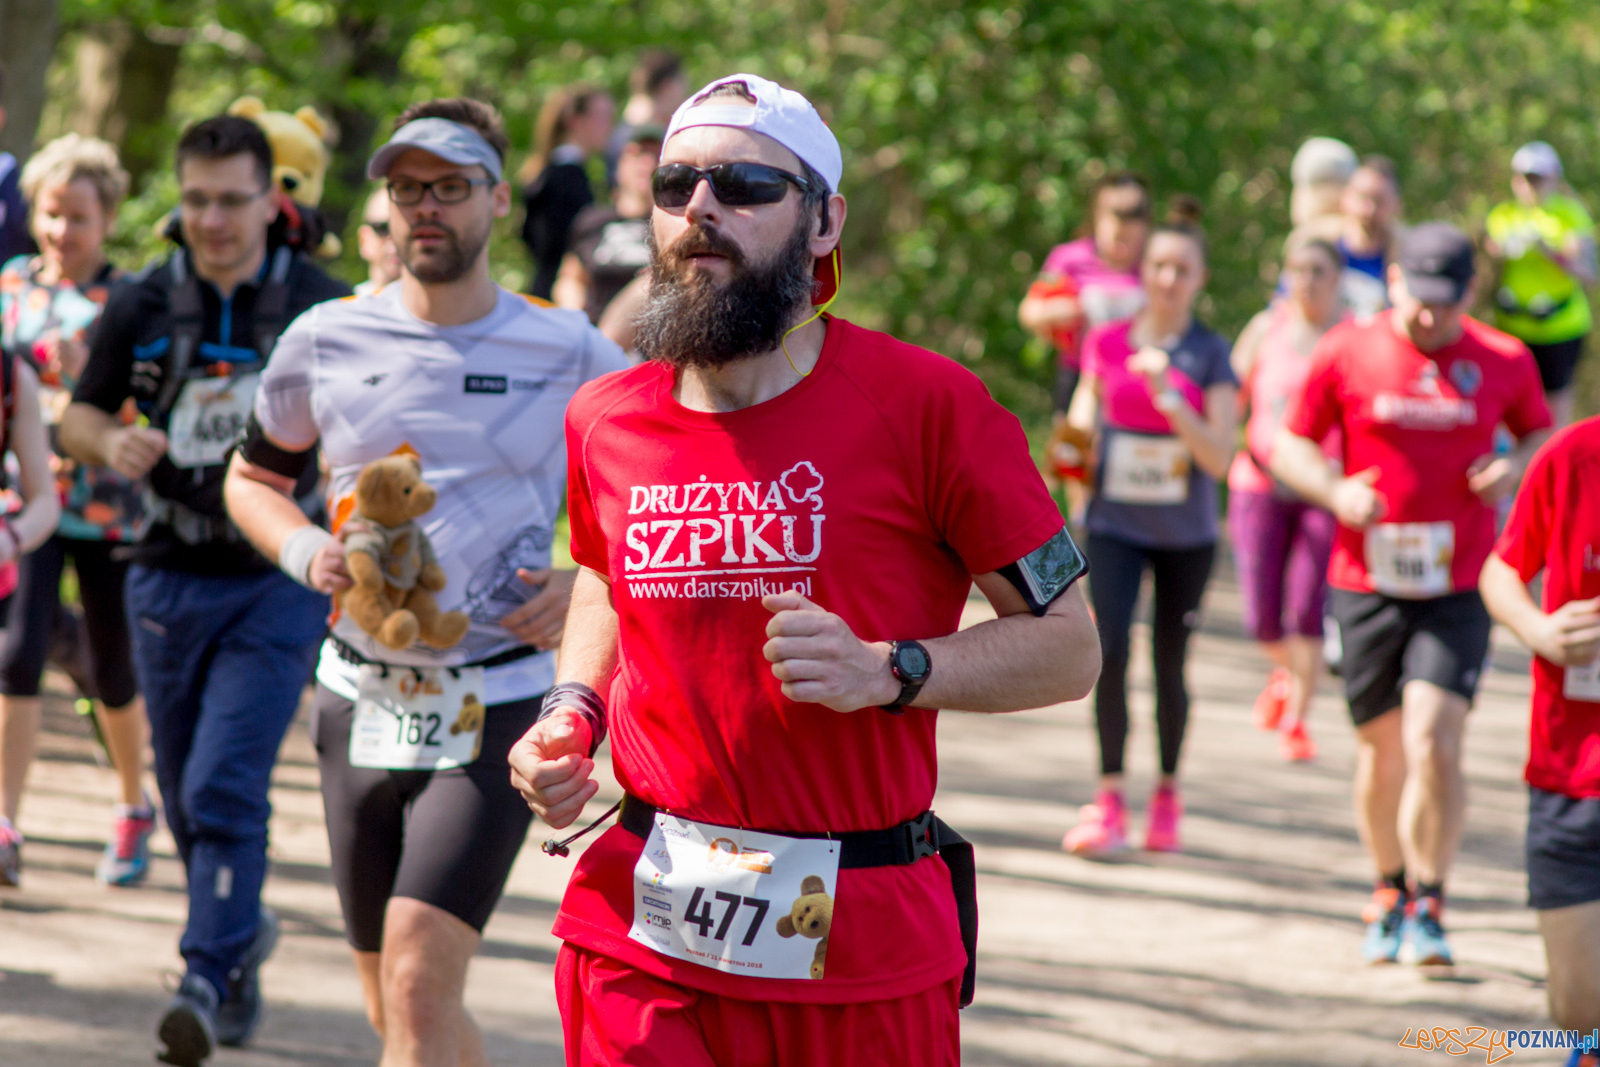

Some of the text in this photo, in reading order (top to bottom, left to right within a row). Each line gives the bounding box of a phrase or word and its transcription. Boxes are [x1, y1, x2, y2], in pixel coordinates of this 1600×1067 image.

[627, 474, 787, 515] DRUŻYNA
[624, 513, 826, 572] SZPIKU
[628, 577, 812, 602] www.darszpikupl
[396, 711, 442, 746] 162
[683, 886, 770, 946] 477
[747, 961, 763, 969] 2018
